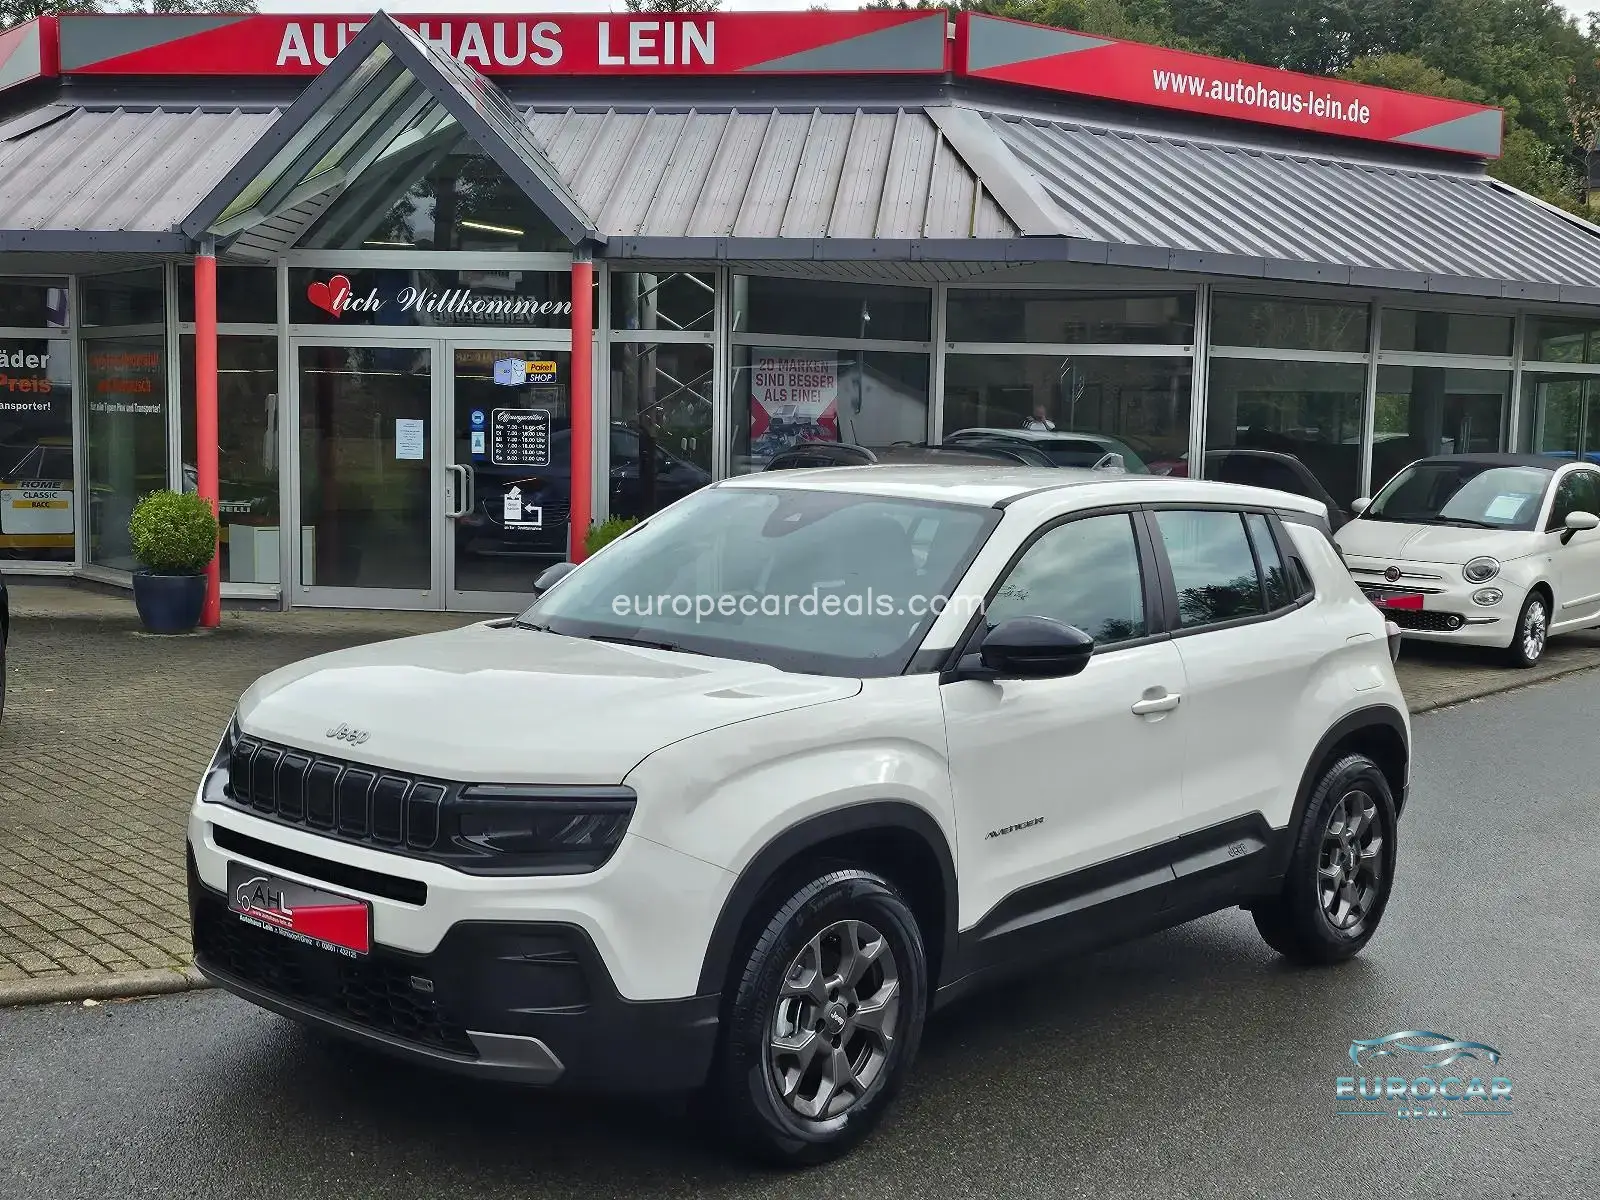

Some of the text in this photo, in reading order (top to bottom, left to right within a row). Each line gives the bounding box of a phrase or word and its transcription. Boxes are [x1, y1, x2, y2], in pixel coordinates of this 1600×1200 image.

[276, 21, 715, 66] AUHAUS LEIN
[1152, 69, 1370, 124] www.autohaus-lein.de
[331, 287, 387, 312] lich
[397, 286, 572, 315] Willkommen
[530, 363, 552, 371] Paket
[779, 360, 829, 373] MARKEN
[530, 374, 552, 382] SHOP
[755, 373, 834, 388] SIND BESSER
[764, 389, 821, 402] ALS EINE!
[23, 491, 57, 499] CLASSIC
[325, 721, 370, 747] Jeep
[252, 884, 293, 916] AHL
[240, 914, 262, 928] Autohaus
